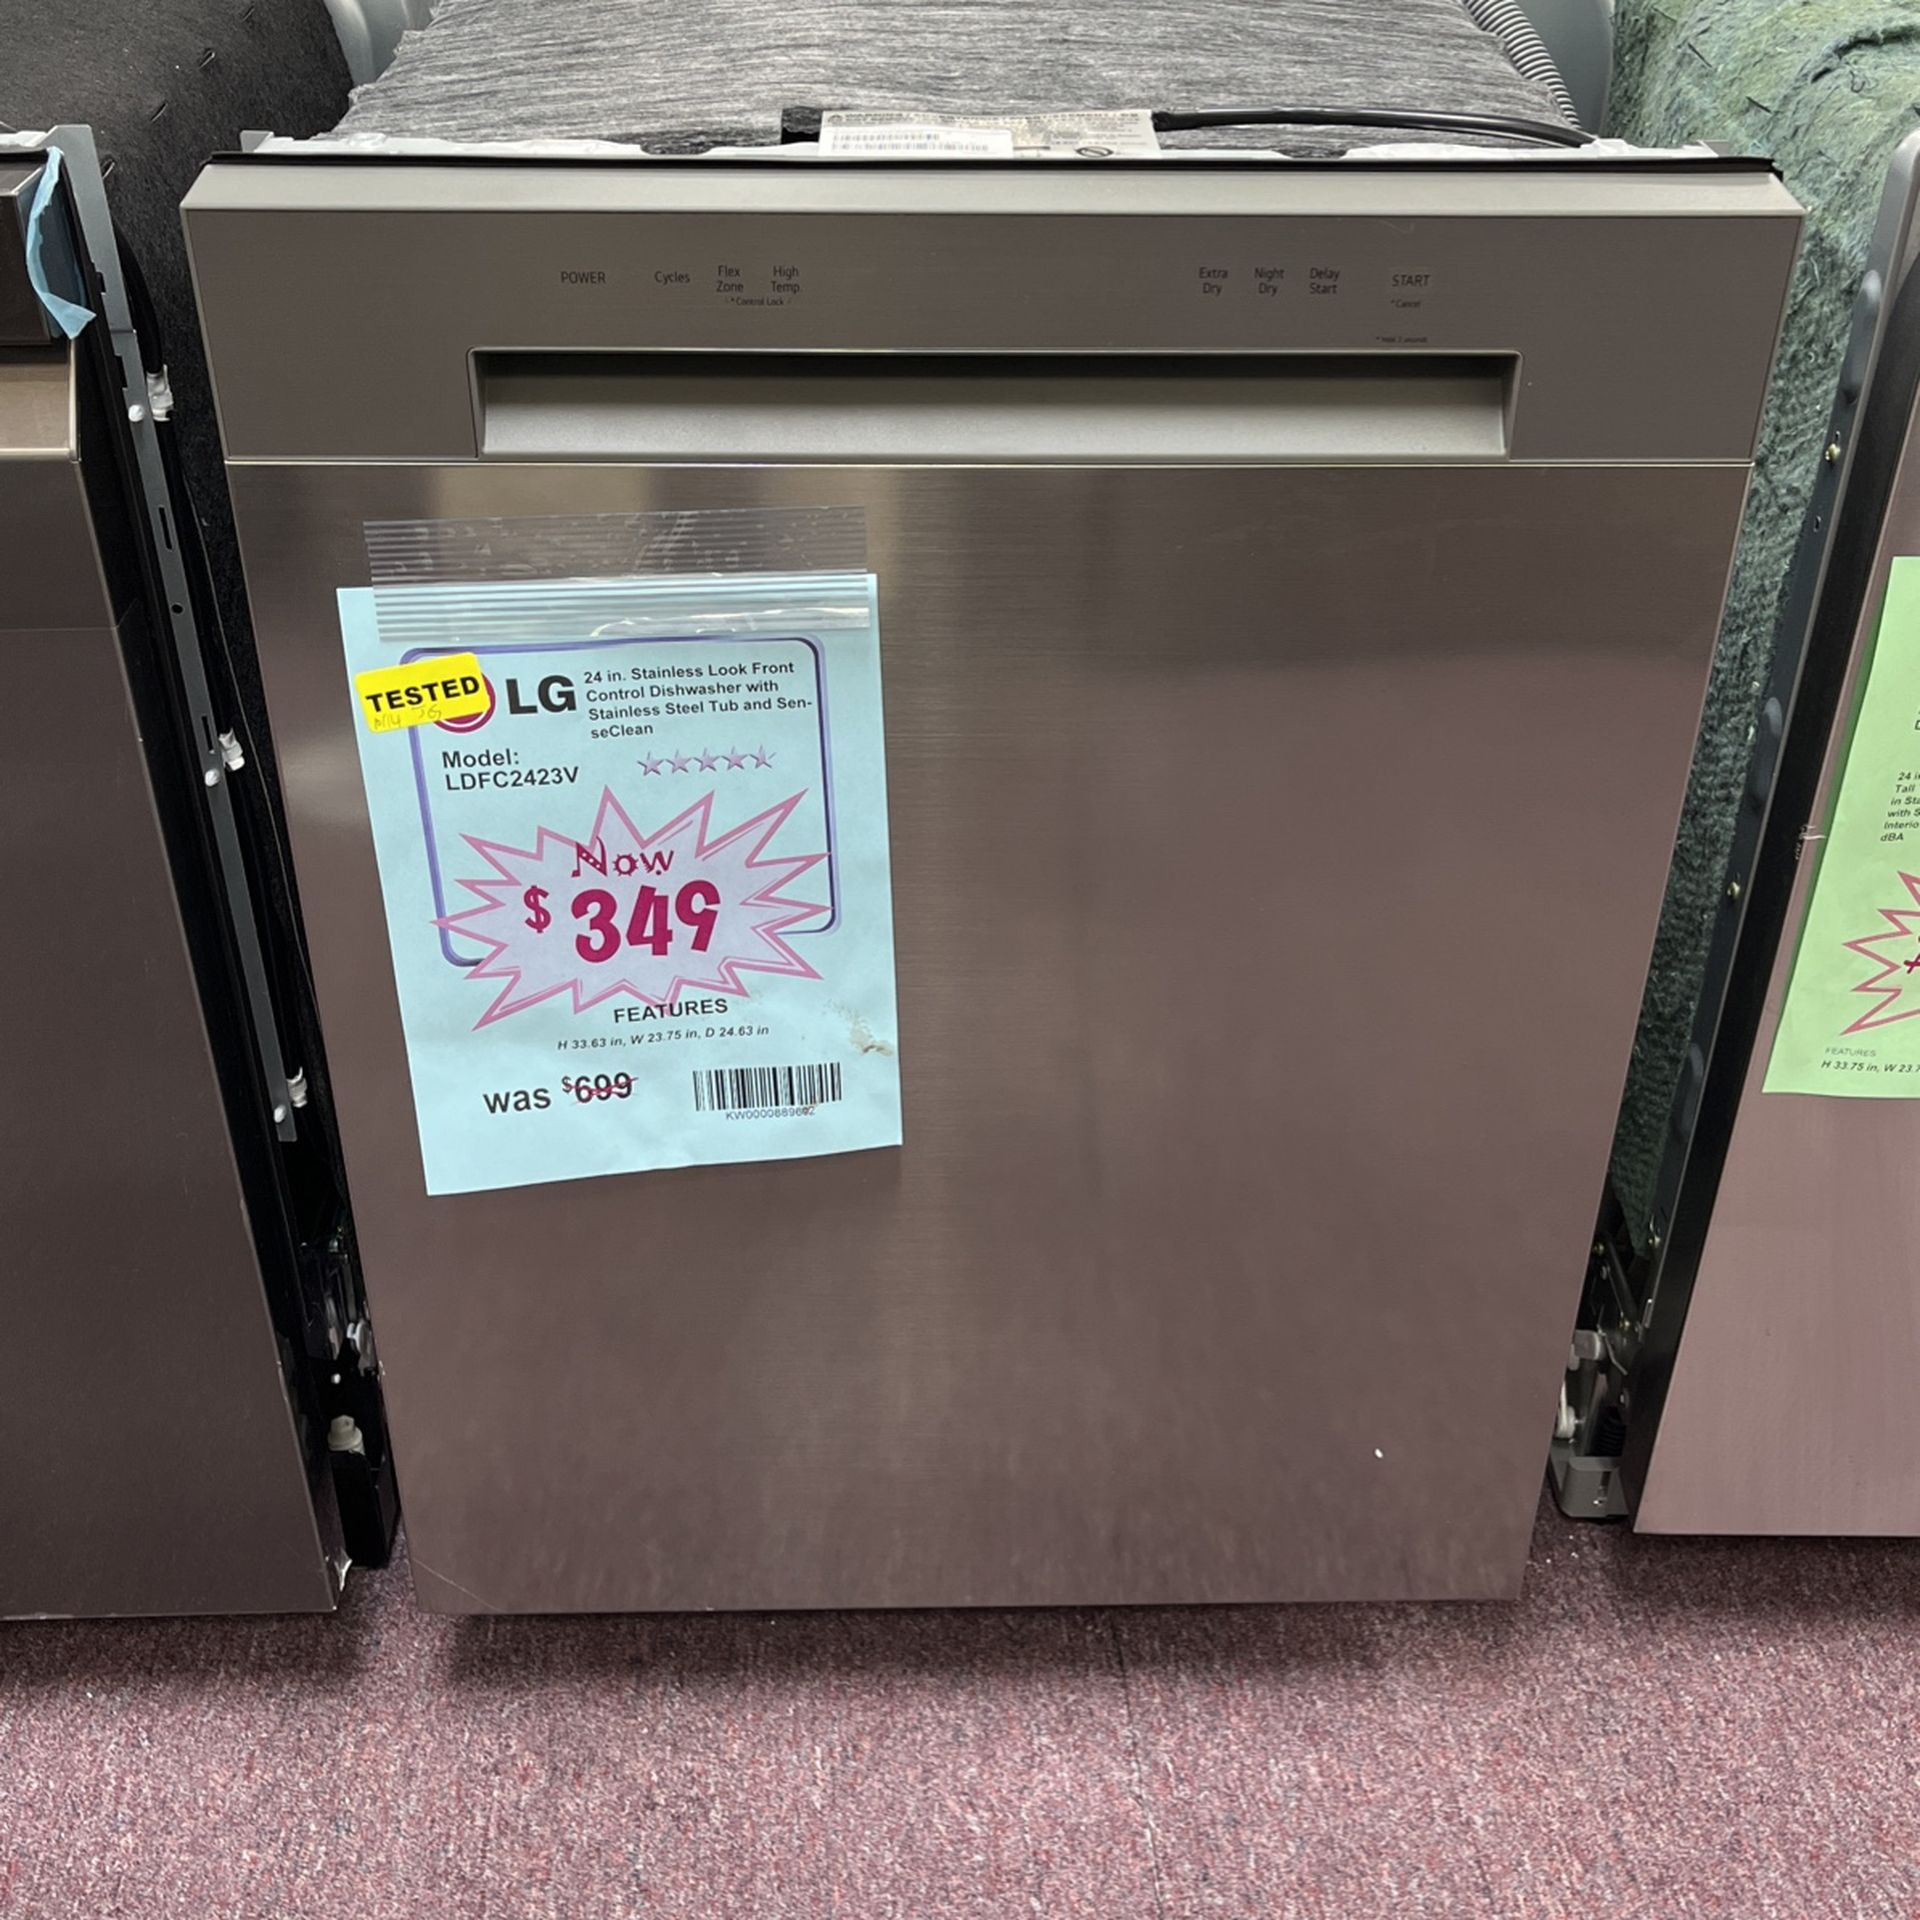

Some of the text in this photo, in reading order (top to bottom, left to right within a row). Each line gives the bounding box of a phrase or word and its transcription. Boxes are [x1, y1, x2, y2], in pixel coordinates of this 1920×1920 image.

[560, 271, 606, 284] POWER
[654, 270, 691, 285] Cycles
[717, 264, 741, 277] Flex
[773, 265, 799, 280] High
[1199, 267, 1229, 279] Extra
[1254, 267, 1285, 282] Night
[1310, 267, 1340, 281] Delay
[716, 280, 744, 293] Zone
[1391, 274, 1431, 287] START
[1202, 282, 1222, 296] Dry
[1258, 282, 1278, 296] Dry
[1309, 283, 1337, 295] Start
[584, 661, 794, 684] 24 in. Stainless Look Front
[365, 675, 481, 714] TESTED
[506, 674, 577, 715] LG
[586, 679, 779, 702] Control Dishwasher with
[588, 696, 813, 721] Stainless Steel Tub and Sen-
[591, 723, 654, 739] seClean
[442, 749, 519, 770] Model:
[446, 766, 579, 792] LDFC2423V
[1898, 771, 1911, 781] 24
[1896, 784, 1916, 793] Tall
[1890, 797, 1902, 806] in
[1888, 808, 1911, 817] with
[1880, 832, 1904, 842] dBA
[523, 879, 721, 963] $ 349
[614, 998, 729, 1024] FEATURES
[557, 1025, 770, 1050] H 33.63 in, W 23.75 in, D 24.63 in
[1825, 1047, 1876, 1057] FEATURES
[1821, 1060, 1832, 1069] H
[1833, 1061, 1864, 1071] 33.75
[1884, 1063, 1897, 1072] W
[483, 1086, 552, 1114] was
